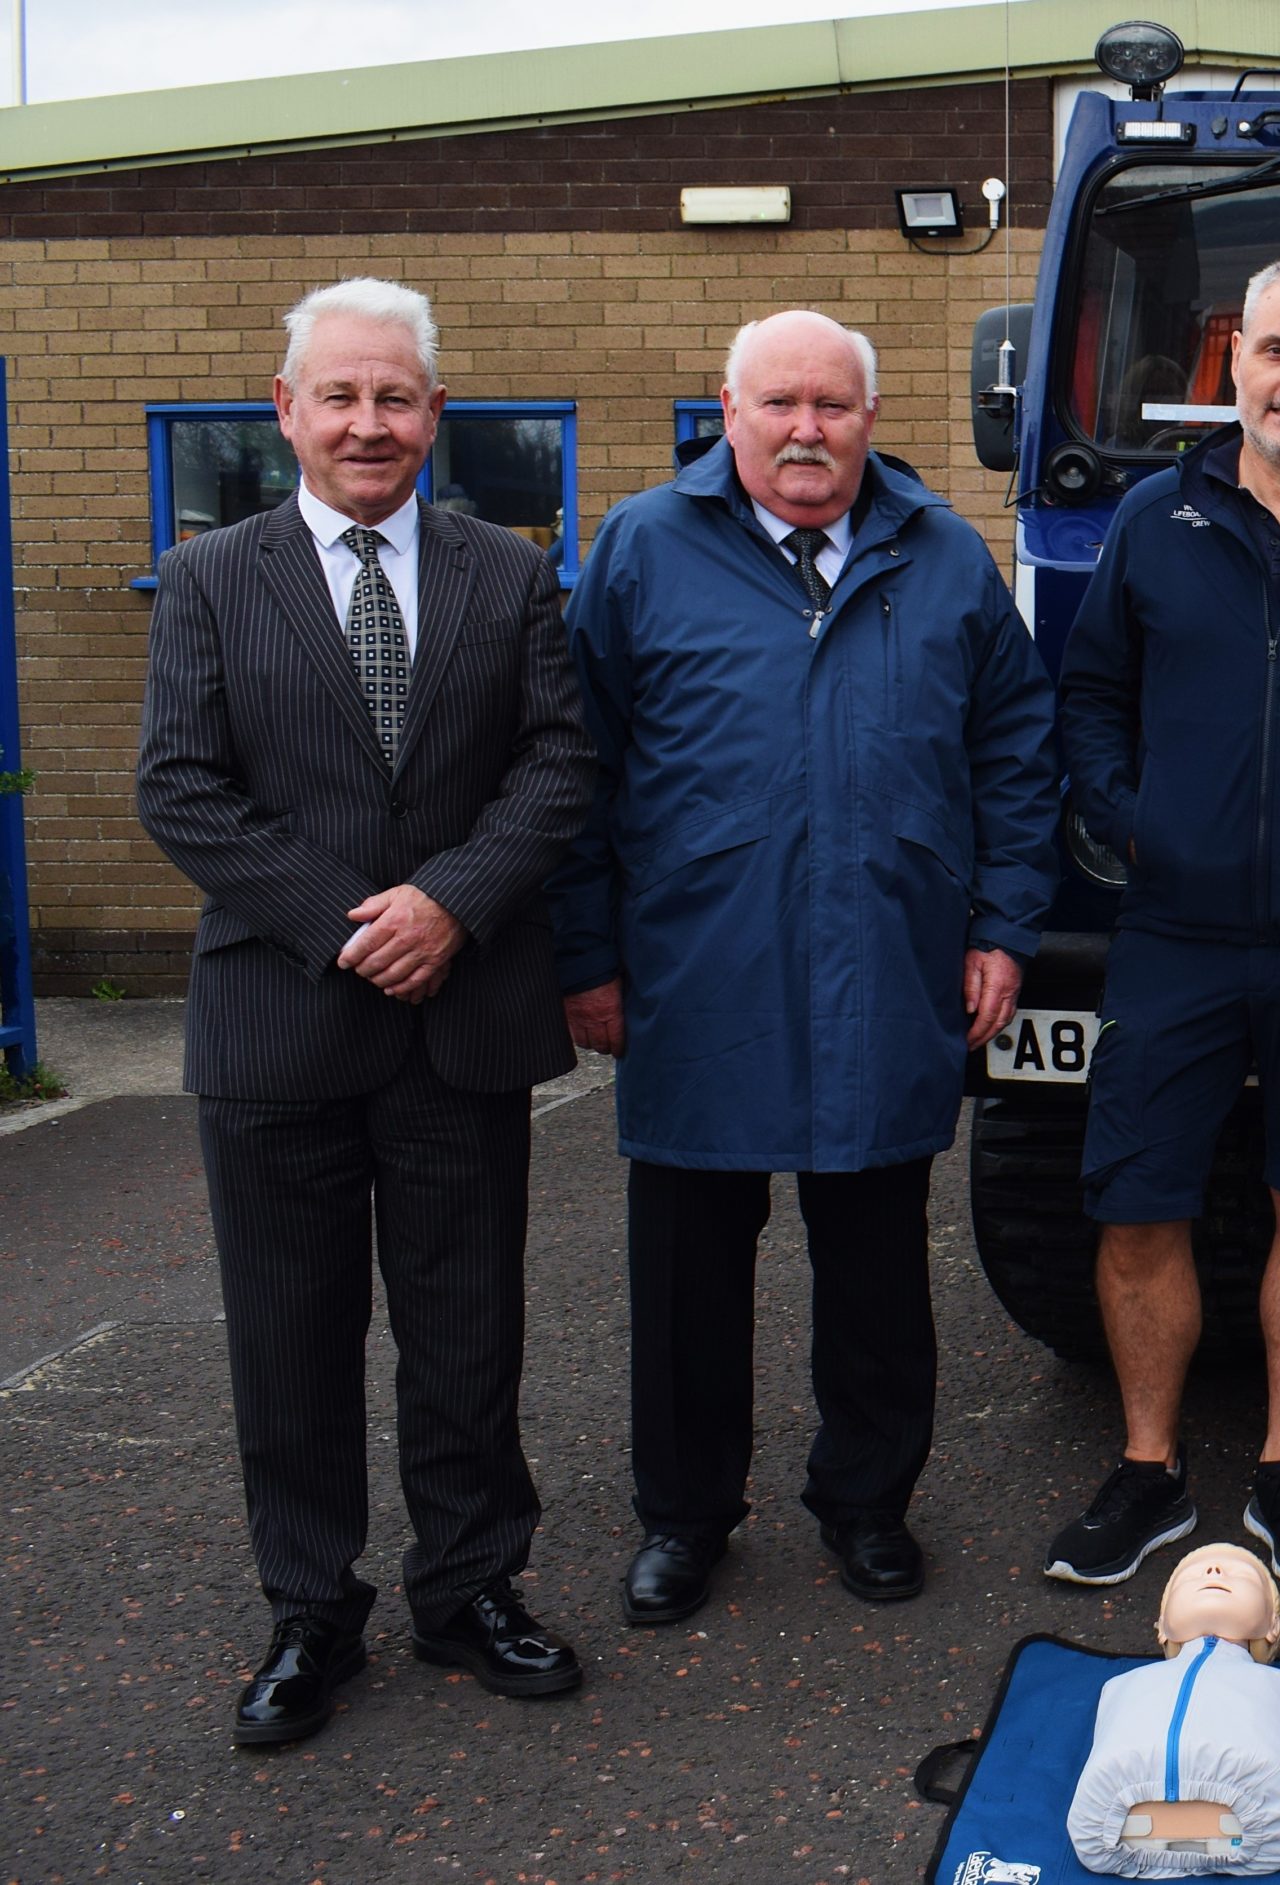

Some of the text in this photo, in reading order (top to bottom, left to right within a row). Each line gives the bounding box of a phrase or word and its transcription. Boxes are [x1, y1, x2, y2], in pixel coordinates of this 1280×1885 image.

[1173, 510, 1202, 518] LIFEBOA
[1192, 520, 1212, 528] CREW
[1013, 1018, 1086, 1072] A8
